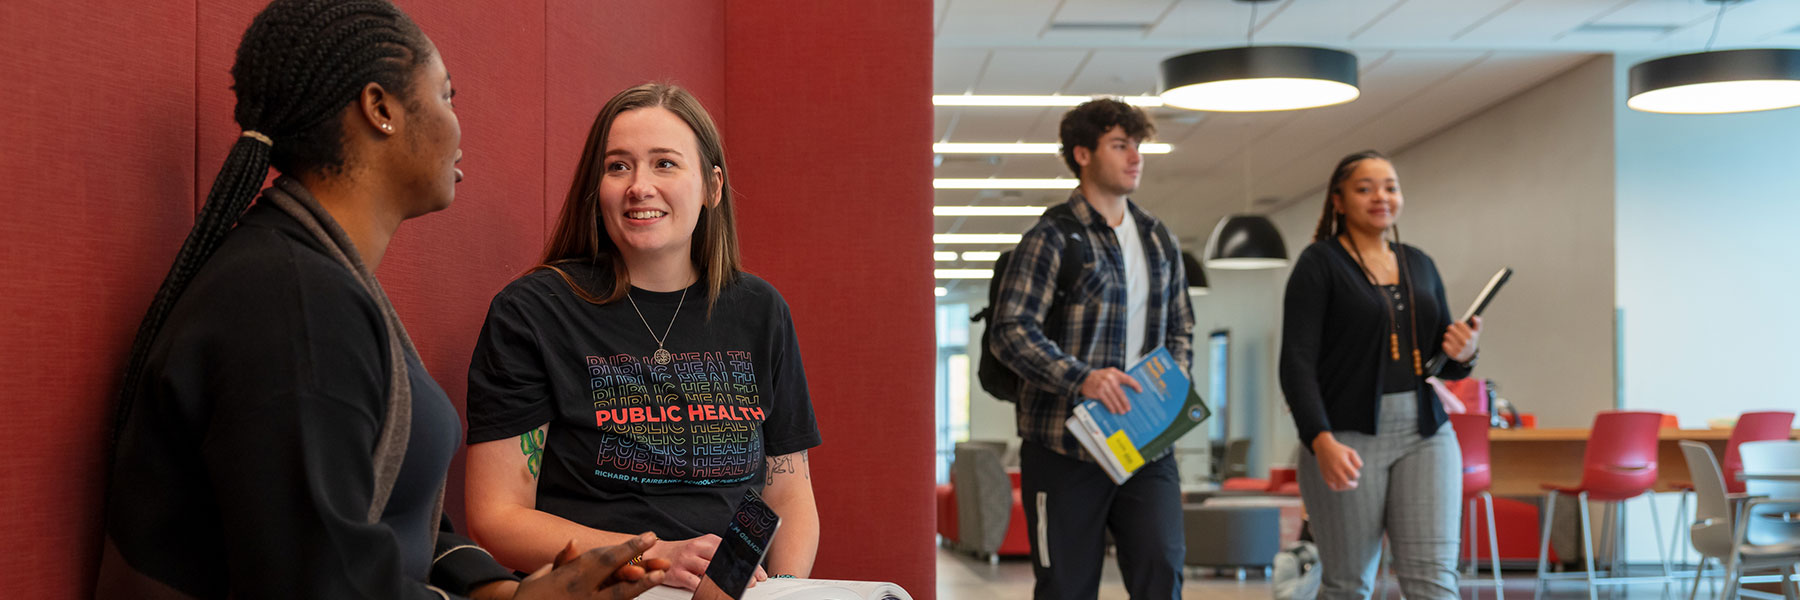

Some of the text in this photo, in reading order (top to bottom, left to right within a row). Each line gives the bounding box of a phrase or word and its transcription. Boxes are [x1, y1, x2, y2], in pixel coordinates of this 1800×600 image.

[586, 354, 657, 366] PUBLI
[596, 404, 766, 427] PUBLIC HEALTH
[690, 421, 760, 434] HEALT
[595, 470, 630, 481] RICHARD
